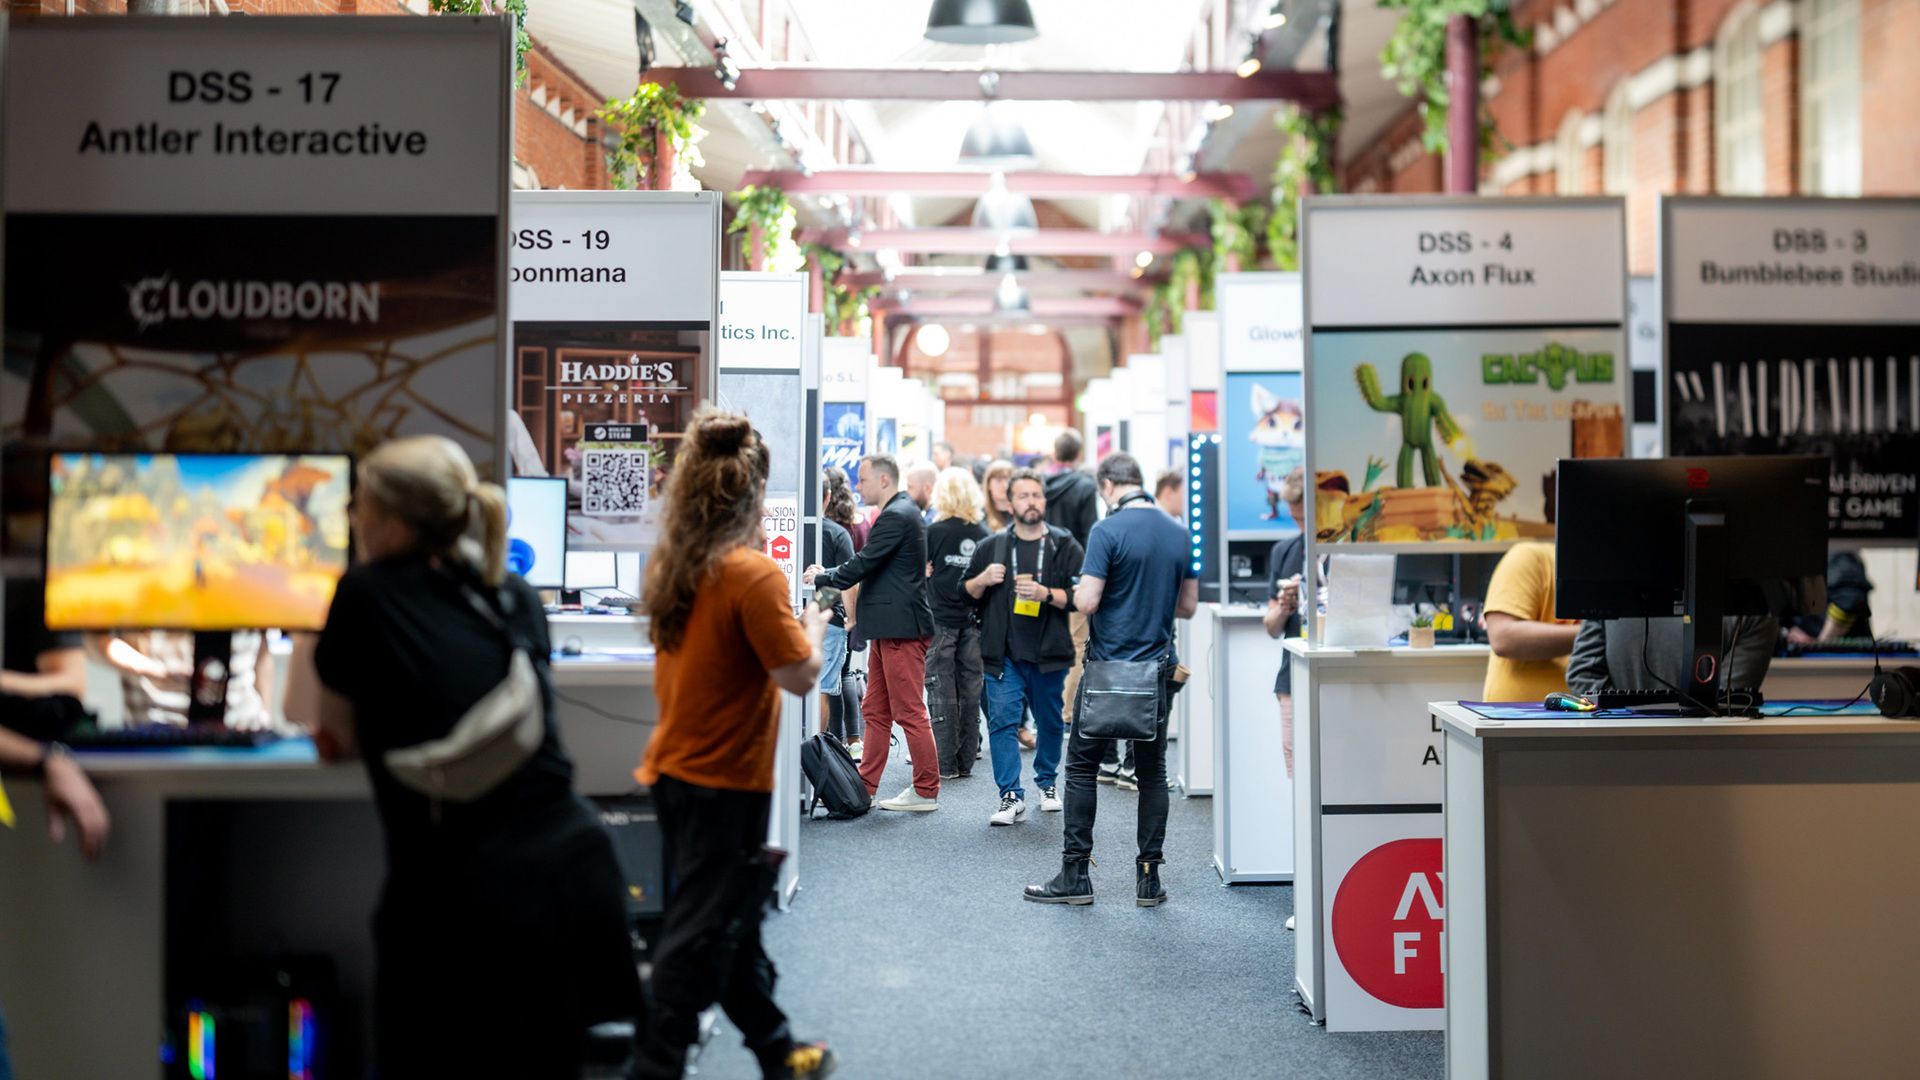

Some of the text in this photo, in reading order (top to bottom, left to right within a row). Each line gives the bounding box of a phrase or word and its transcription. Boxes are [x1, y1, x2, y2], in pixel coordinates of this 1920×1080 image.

[168, 71, 342, 104] DSS - 17
[79, 121, 428, 155] Antler Interactive
[511, 229, 553, 250] SS
[581, 229, 610, 250] 19
[1418, 231, 1473, 252] DSS
[1499, 231, 1513, 252] 4
[1772, 228, 1828, 252] DSS
[1851, 229, 1868, 252] 3
[511, 266, 627, 283] oonmana
[1410, 264, 1535, 286] Axon Flux
[1700, 261, 1843, 285] Bumblebee
[127, 274, 380, 327] CLOUDBORN
[720, 324, 796, 340] tics Inc.
[1481, 343, 1615, 391] CACTUS
[562, 393, 671, 404] PIZZERIA
[1844, 497, 1902, 518] GAME
[763, 518, 796, 532] CTED
